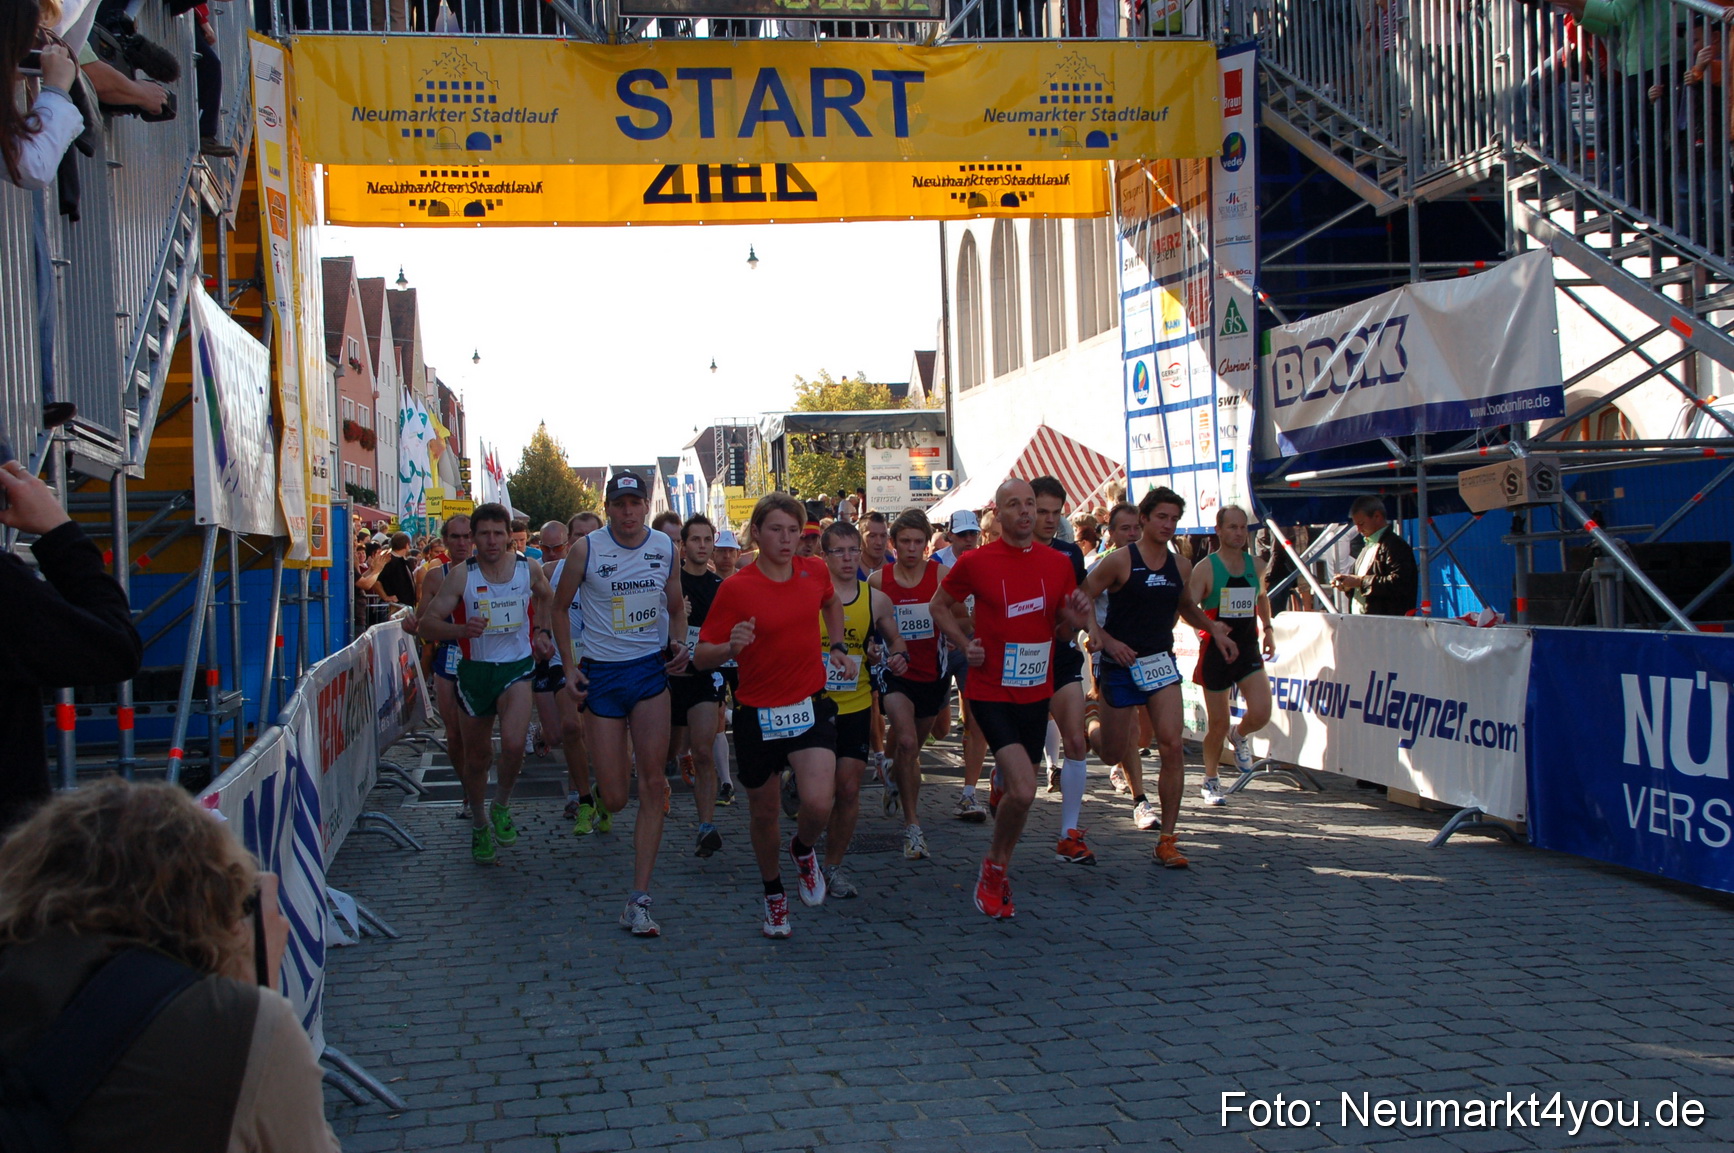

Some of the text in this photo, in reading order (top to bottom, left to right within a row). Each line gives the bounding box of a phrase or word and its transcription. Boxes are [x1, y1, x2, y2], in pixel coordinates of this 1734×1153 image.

[614, 67, 925, 140] START
[351, 106, 559, 123] Neumarkter Stadtlauf
[983, 106, 1169, 123] Neumarkter Stadtlauf
[367, 180, 544, 194] Neumarkter Stadtlauf
[913, 173, 1071, 187] Neumarkter Stadtlauf
[1272, 314, 1409, 408] BOCK
[611, 579, 656, 591] ERDINGER
[490, 600, 517, 609] Christian
[1231, 600, 1252, 609] 1089
[504, 612, 510, 623] 1
[628, 607, 657, 623] 1066
[898, 608, 913, 616] Felix
[901, 619, 930, 631] 2888
[1019, 647, 1041, 657] Rainer
[1019, 660, 1047, 675] 2507
[1145, 665, 1173, 681] 2003
[774, 711, 810, 726] 3188
[1620, 670, 1730, 780] NÜ
